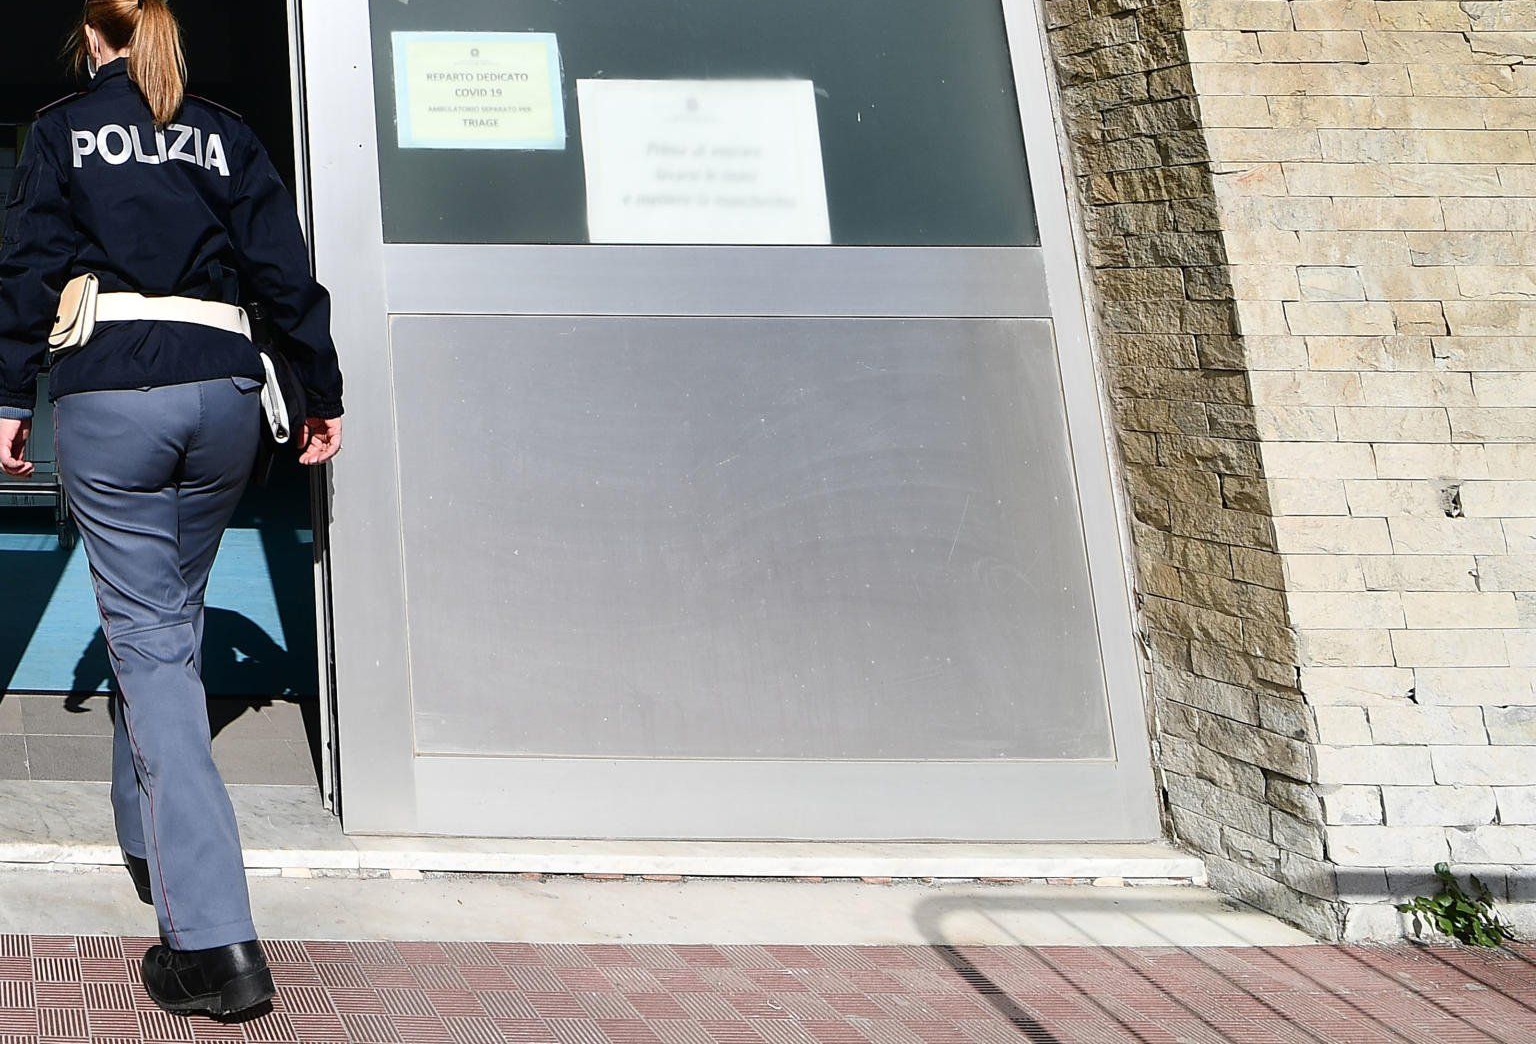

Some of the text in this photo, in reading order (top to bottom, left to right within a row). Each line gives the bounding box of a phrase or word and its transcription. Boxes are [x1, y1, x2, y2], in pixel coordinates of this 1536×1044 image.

[426, 72, 529, 82] REPARTO DEDICATO
[454, 88, 503, 98] COVID 19
[462, 118, 499, 128] TRIAGE
[70, 123, 231, 176] POLIZIA
